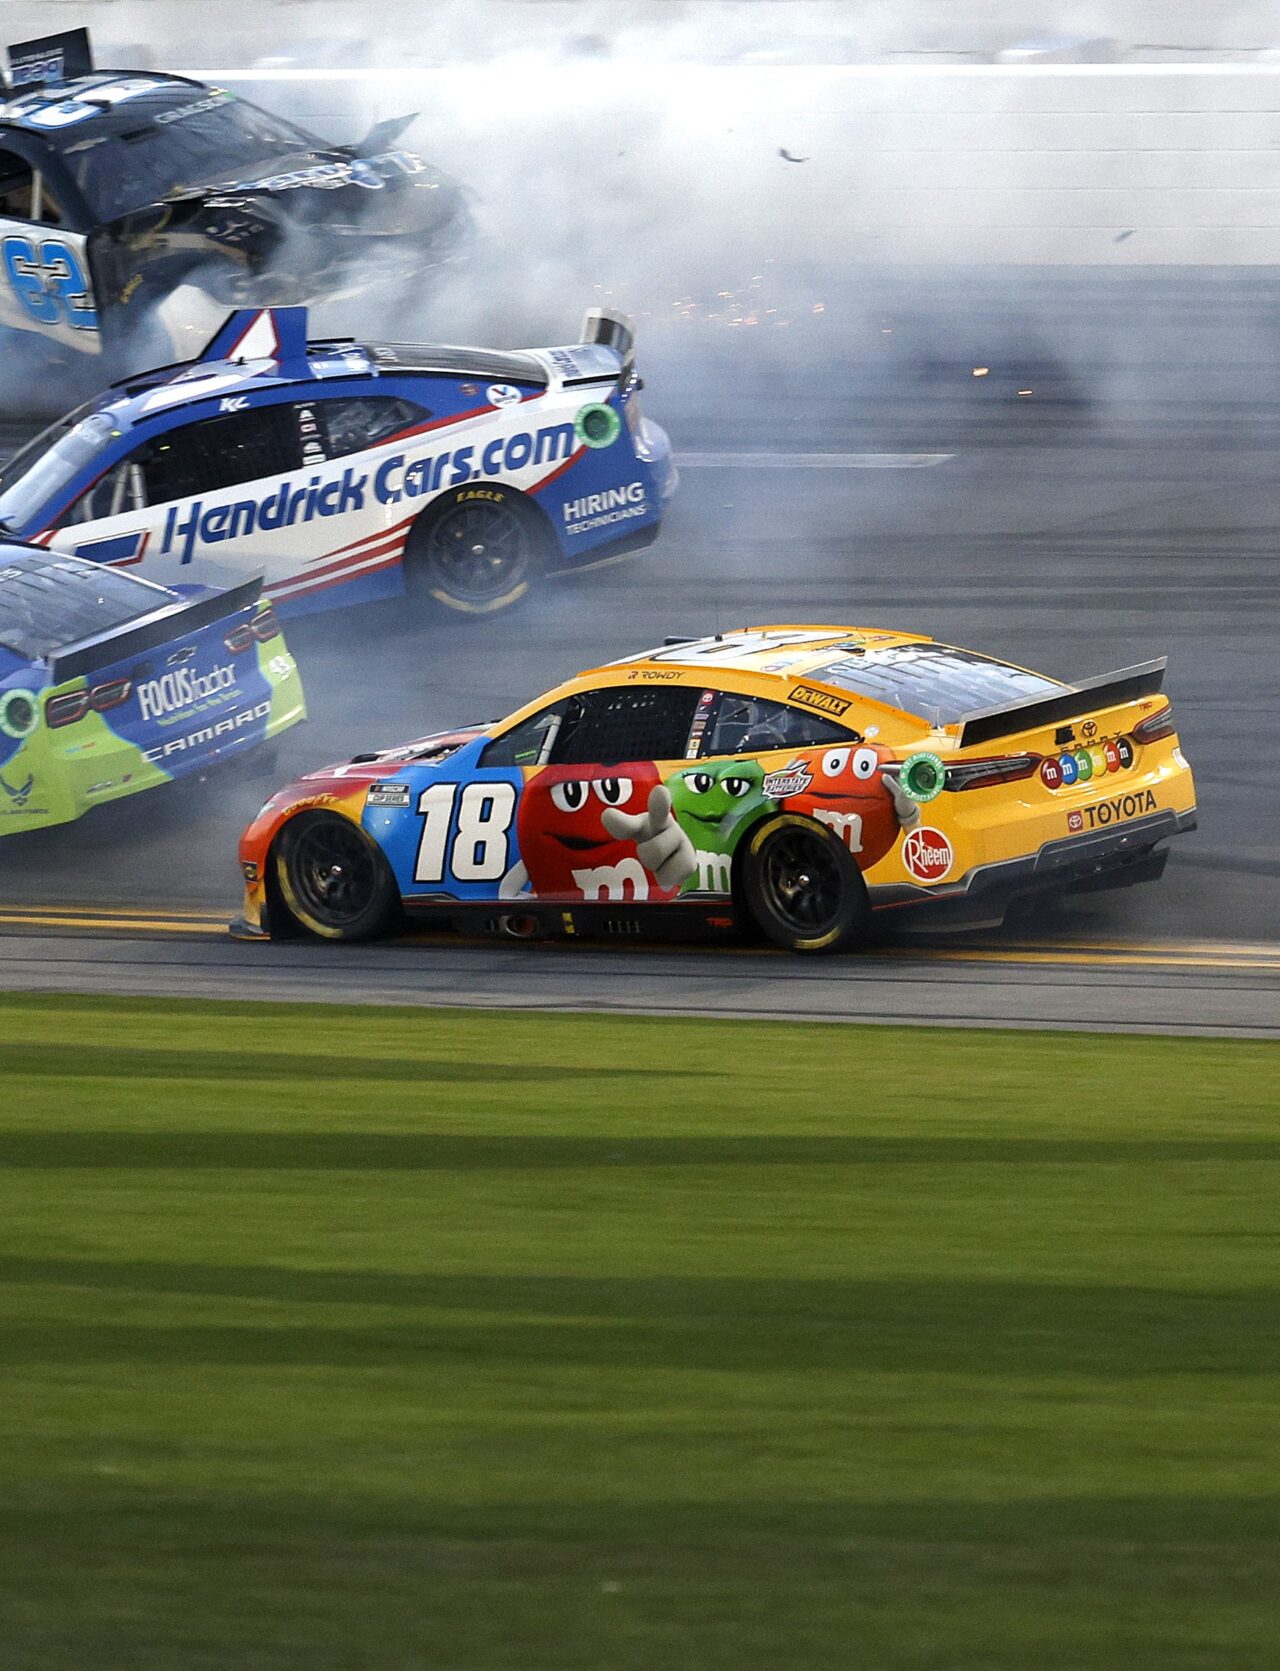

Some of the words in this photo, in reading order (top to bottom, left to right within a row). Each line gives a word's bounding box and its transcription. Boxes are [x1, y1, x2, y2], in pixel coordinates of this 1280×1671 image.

[456, 490, 505, 503] EAGLE
[563, 482, 645, 521] HIRING
[566, 504, 647, 535] TECHNICIANS
[641, 671, 686, 680] ROWDY
[141, 700, 272, 764] CAMARO
[1084, 790, 1158, 828] TOYOTA
[414, 780, 517, 884] 18
[812, 807, 865, 854] m
[904, 837, 952, 874] Rheem
[571, 857, 650, 900] m
